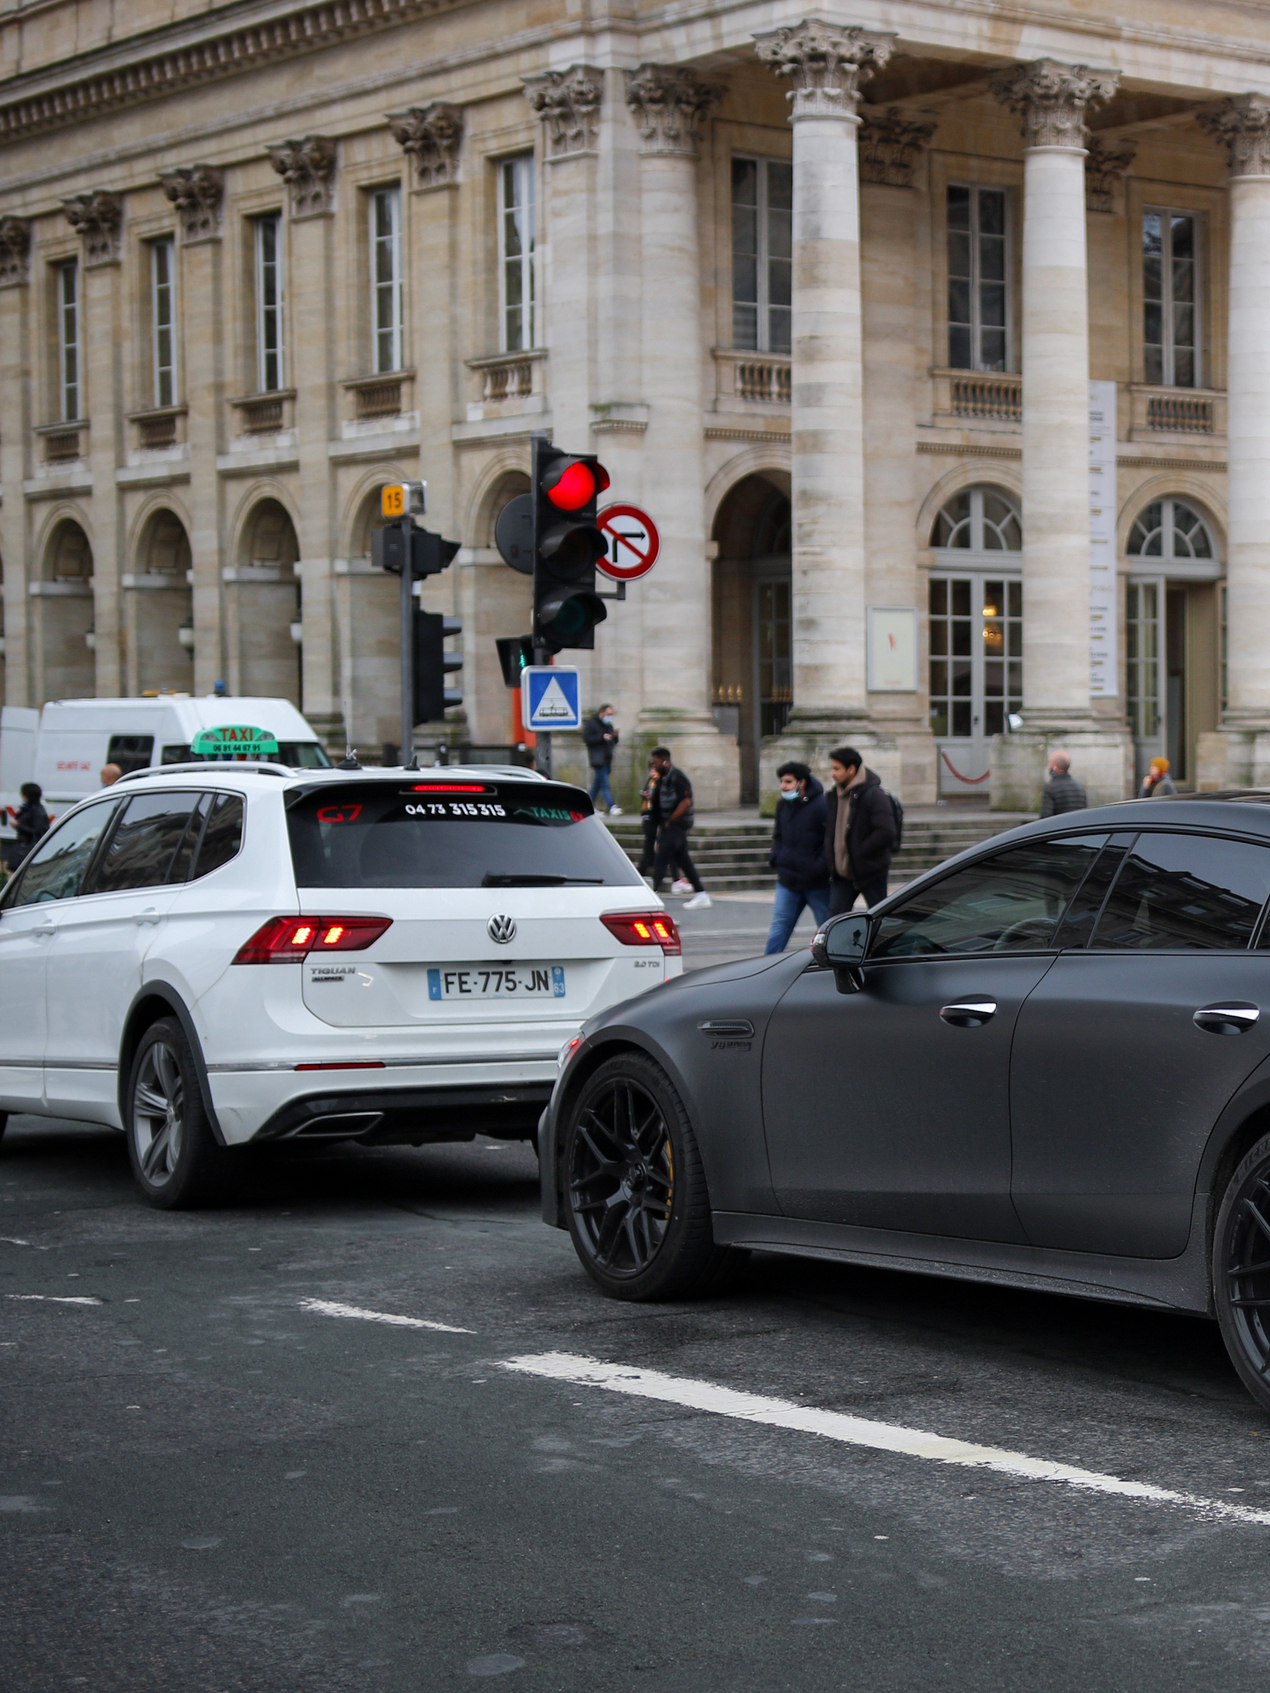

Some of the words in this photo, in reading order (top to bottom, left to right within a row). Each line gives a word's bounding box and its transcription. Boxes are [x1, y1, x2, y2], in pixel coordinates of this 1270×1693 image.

[387, 492, 401, 509] 15
[219, 728, 254, 742] TAXI
[316, 804, 363, 823] G7
[405, 804, 426, 815] 04
[427, 804, 446, 815] 73
[311, 966, 356, 975] TIGUAN
[444, 970, 549, 993] FE-775-JN
[553, 982, 565, 993] 63
